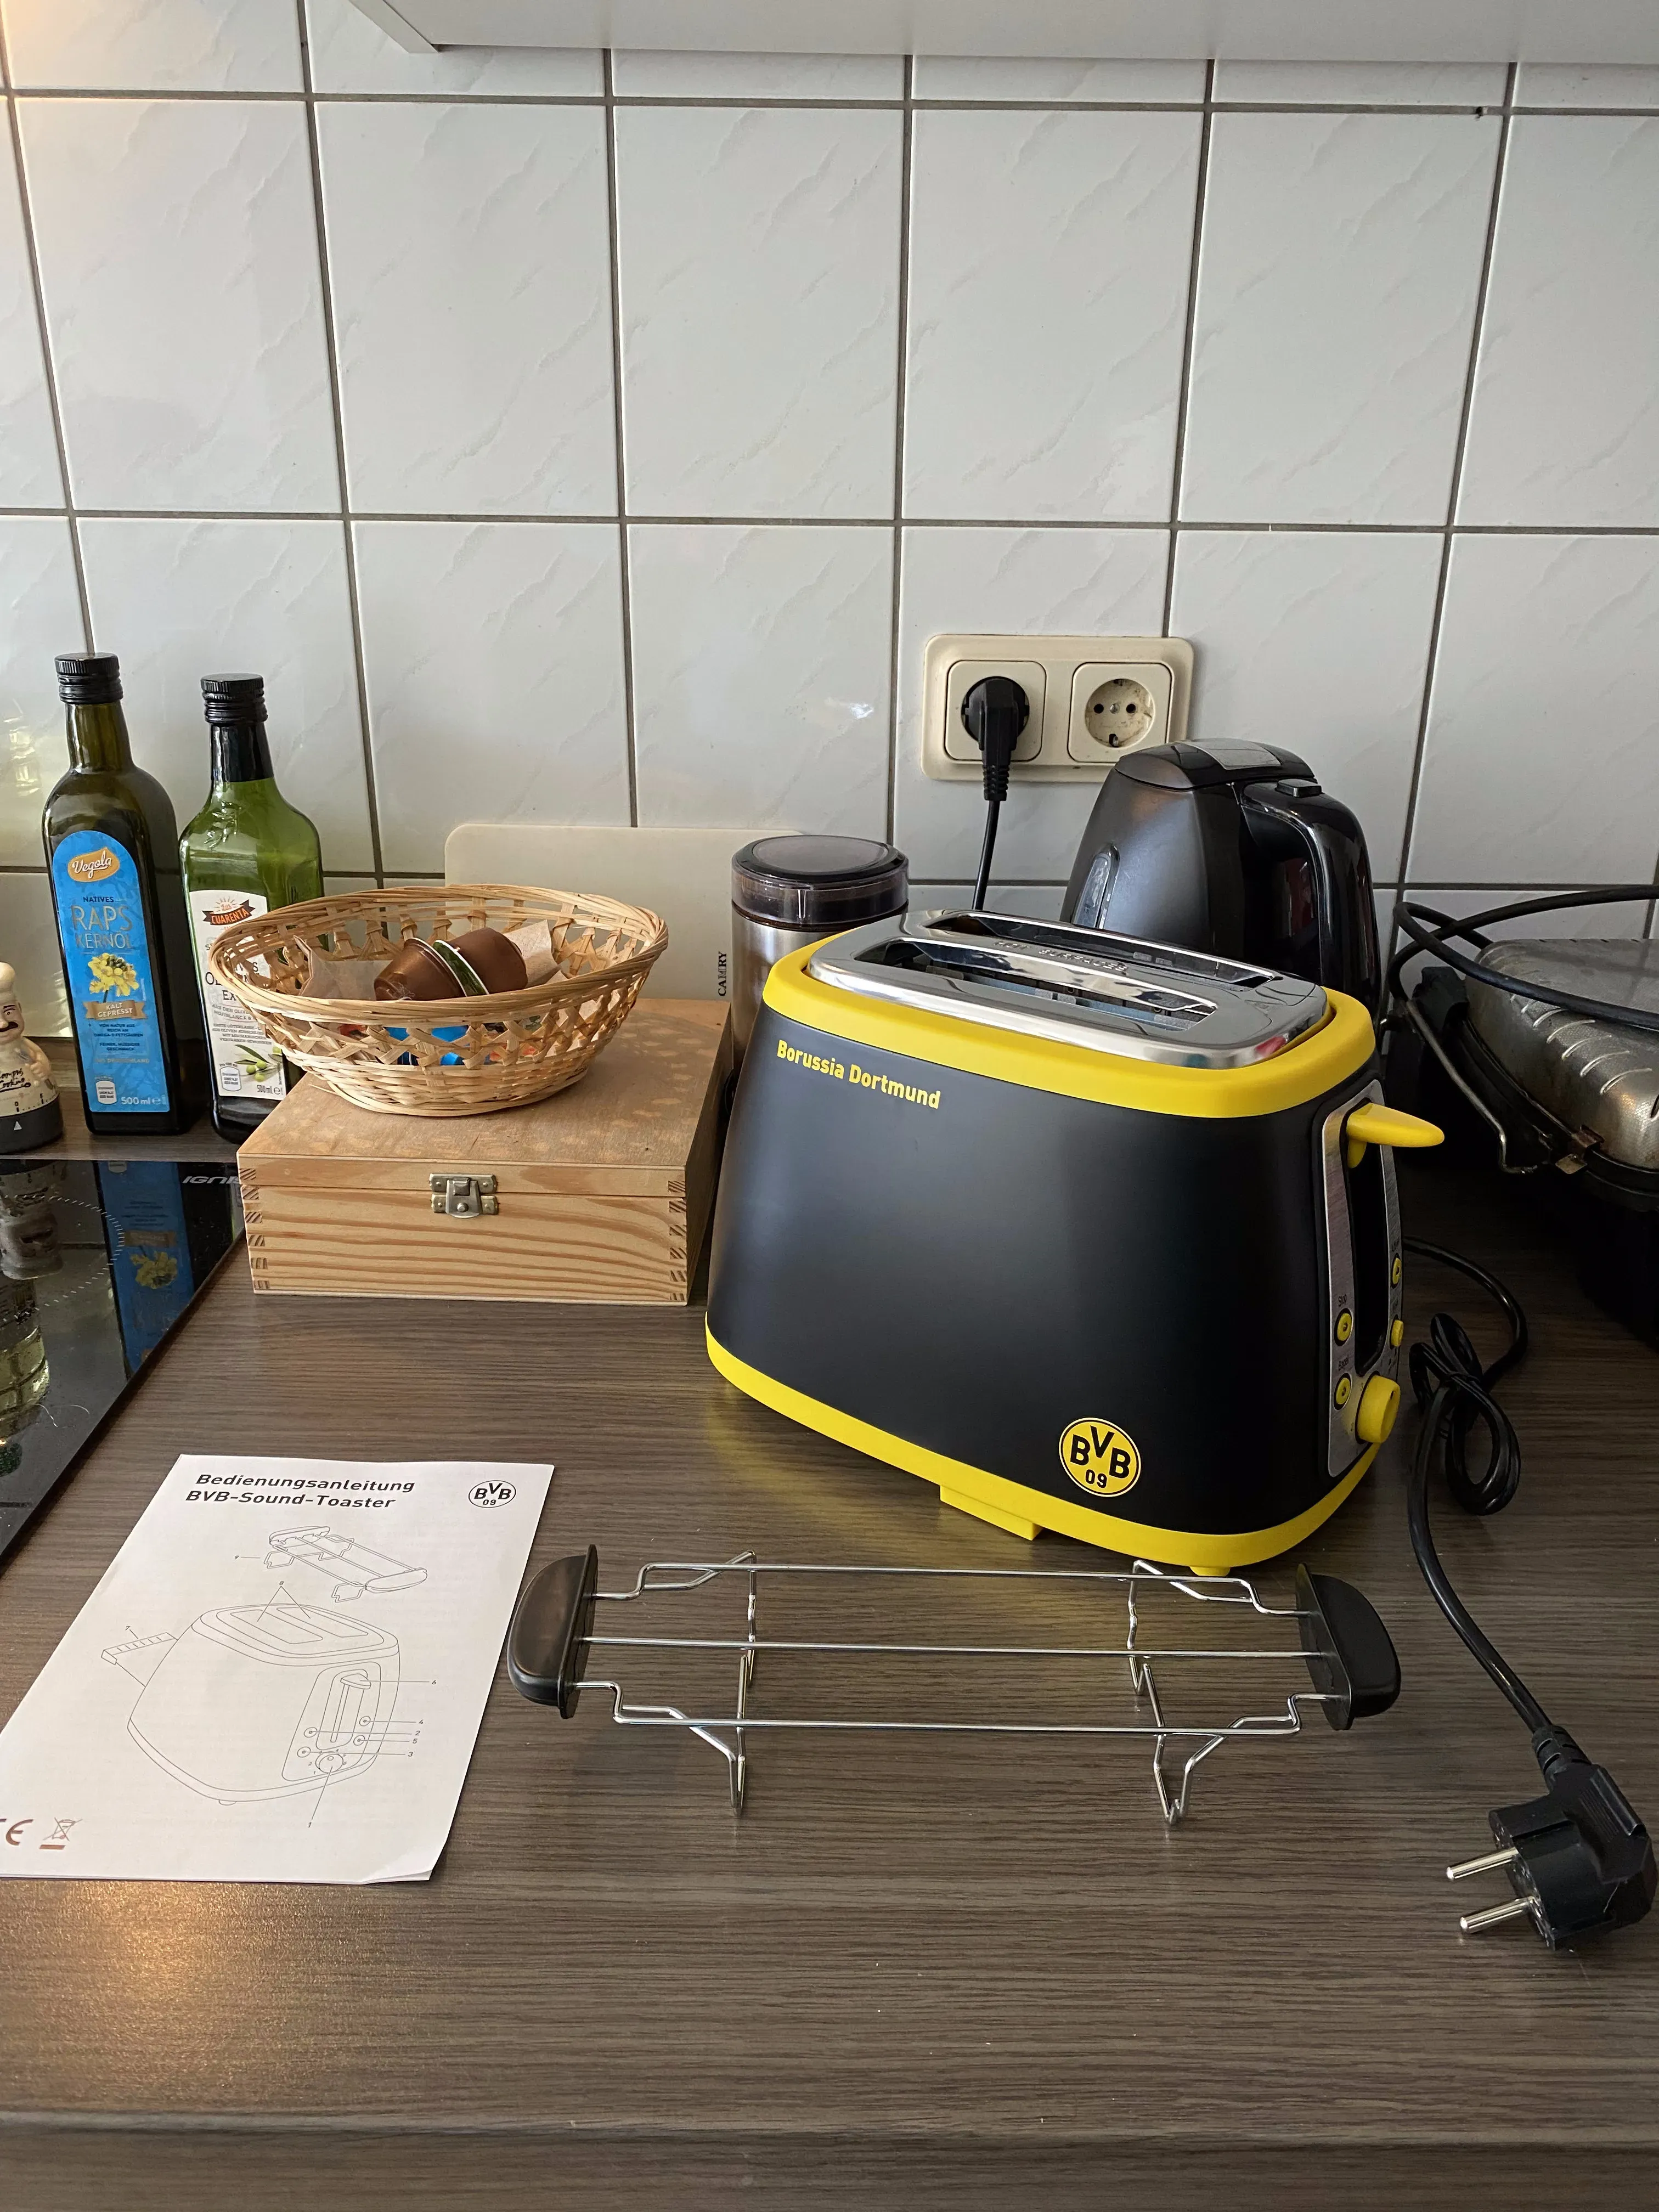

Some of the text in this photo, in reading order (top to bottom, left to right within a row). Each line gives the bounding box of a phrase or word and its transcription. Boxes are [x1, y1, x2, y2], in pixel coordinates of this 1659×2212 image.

[72, 850, 112, 879] Vegola
[71, 905, 133, 931] RAPS
[211, 908, 250, 924] CUARENTA
[75, 931, 134, 949] KERNÖL
[718, 951, 727, 997] CAMRY
[98, 1008, 133, 1018] GEPRESST
[777, 1040, 941, 1110] Borussia Dortmund
[121, 1097, 139, 1105] 500
[140, 1097, 151, 1105] ml
[1070, 1425, 1131, 1479] BVB
[196, 1474, 415, 1493] Bedienungsanleitung
[1085, 1469, 1107, 1488] 09
[185, 1490, 396, 1508] BVB-Sound-Toaster
[474, 1482, 512, 1500] BVB
